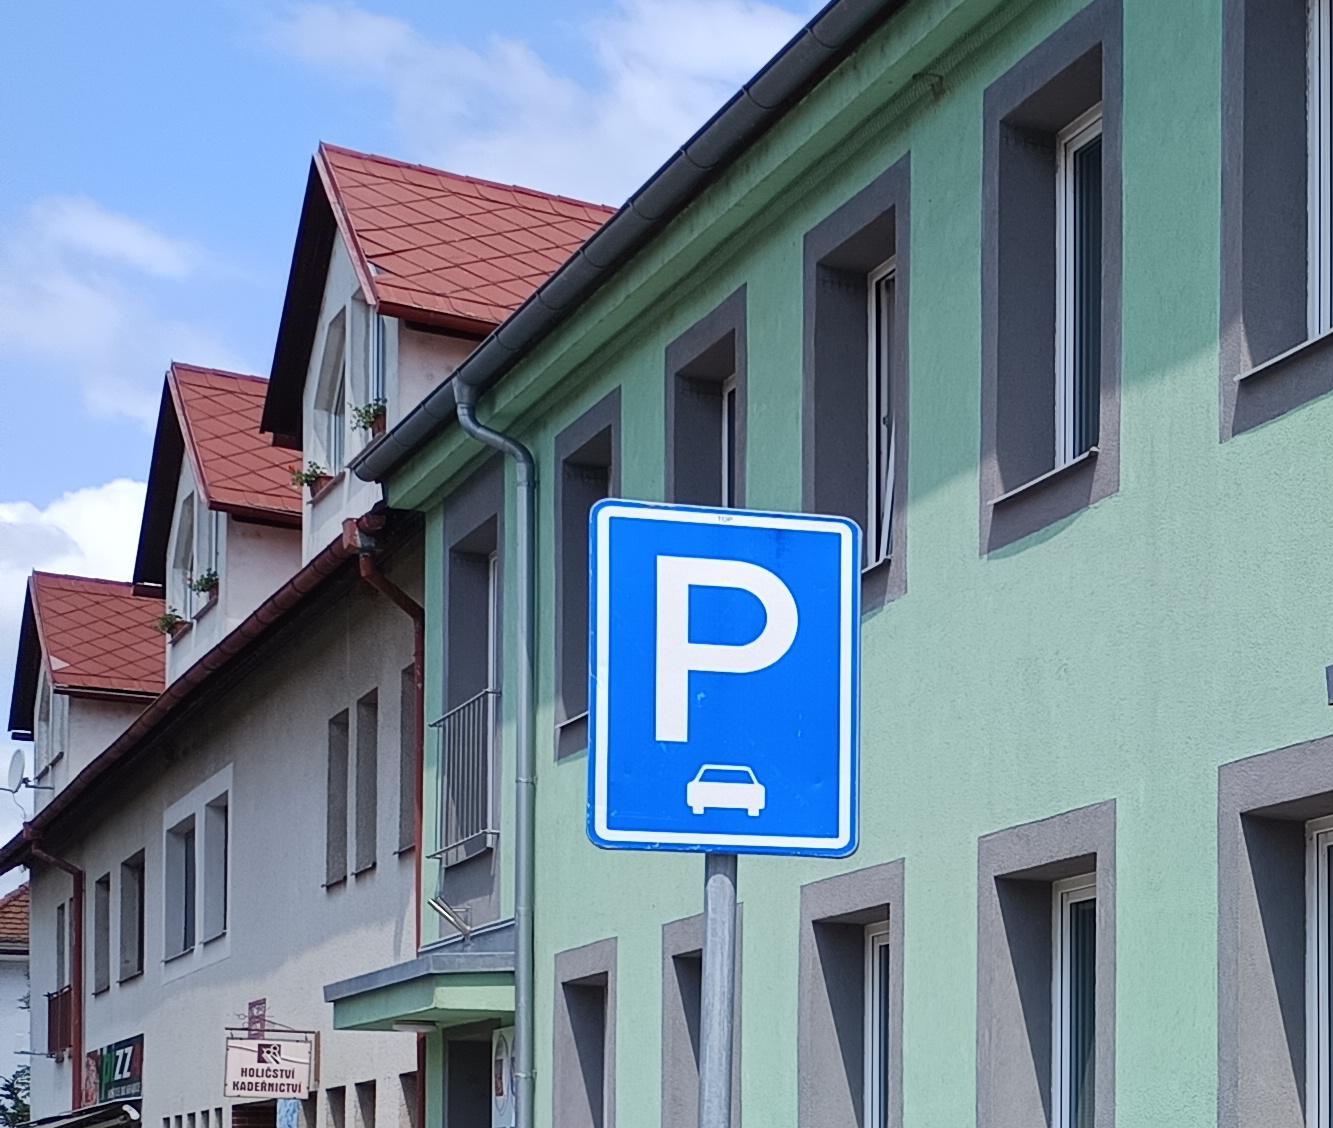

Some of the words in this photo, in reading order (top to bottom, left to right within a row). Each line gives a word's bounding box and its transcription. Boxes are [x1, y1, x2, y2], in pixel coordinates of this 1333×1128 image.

[655, 555, 799, 742] P
[240, 1066, 295, 1079] HOLIČSTVÍ
[232, 1080, 302, 1093] KADEŘNICTVÍ
